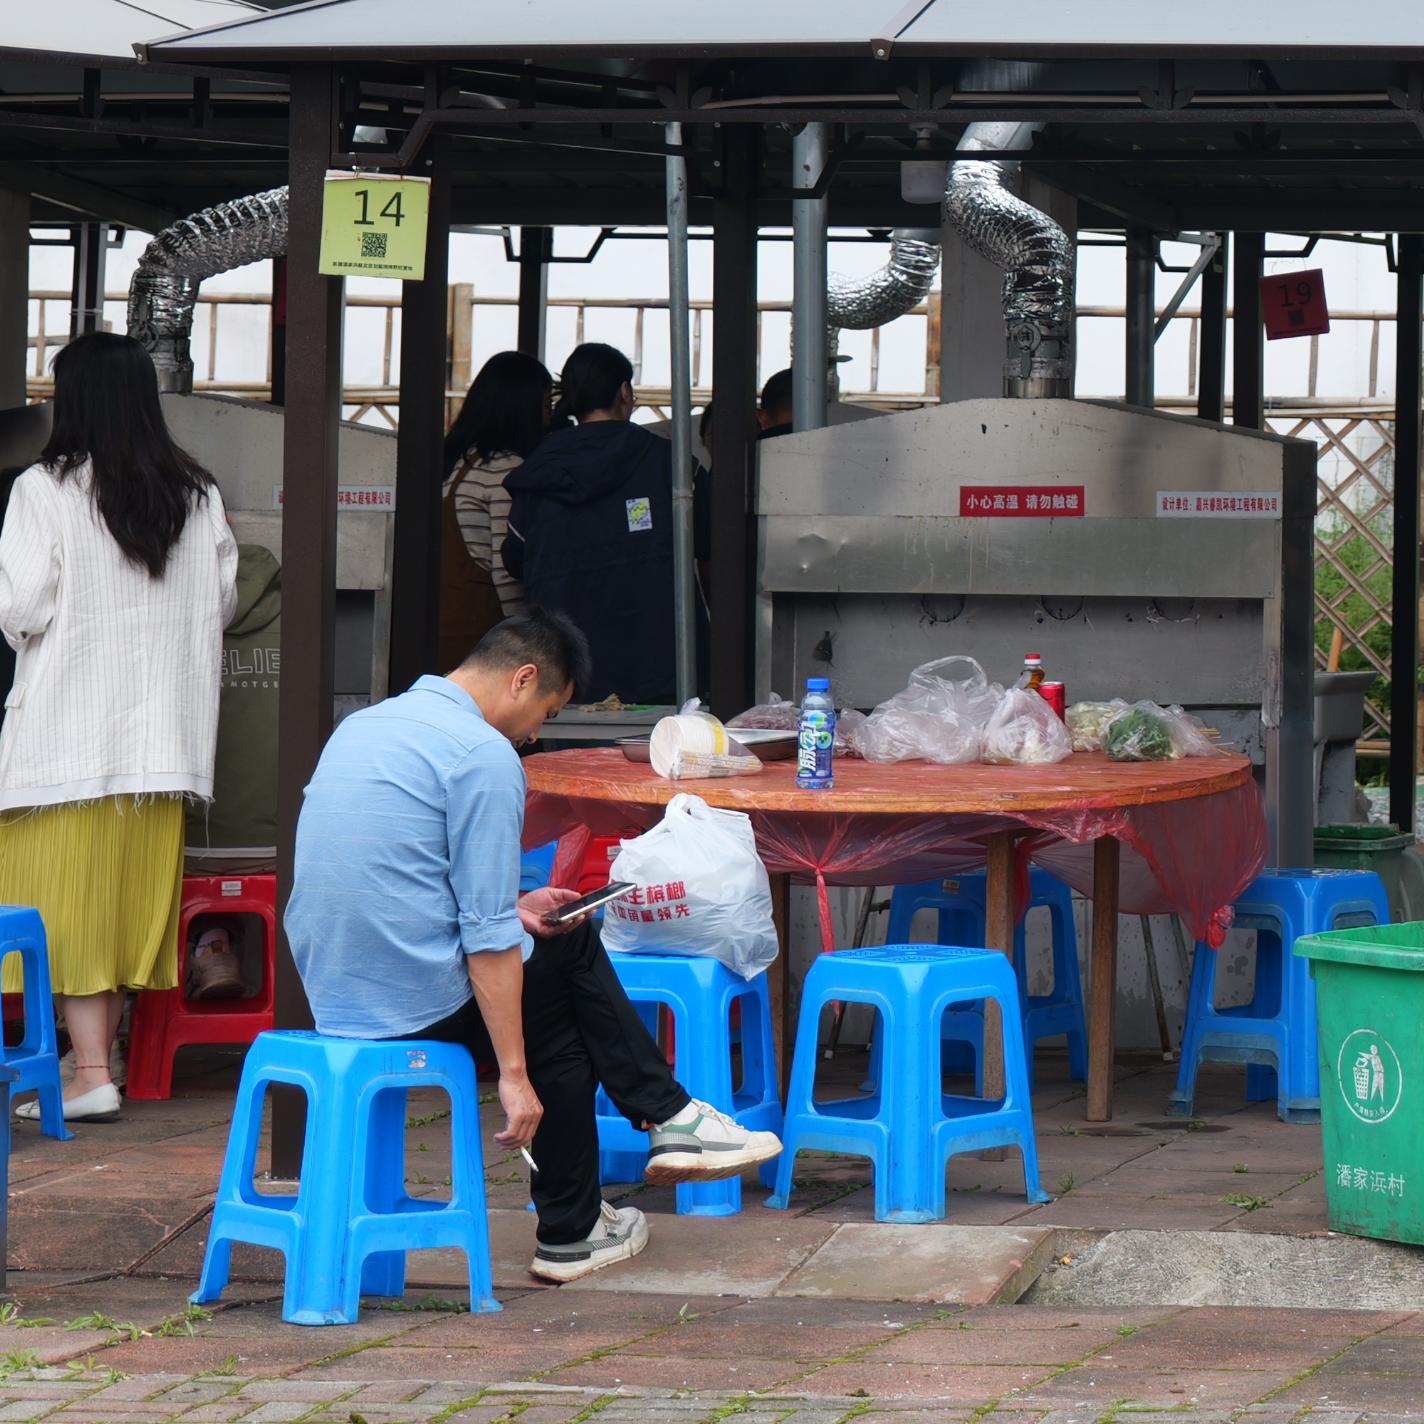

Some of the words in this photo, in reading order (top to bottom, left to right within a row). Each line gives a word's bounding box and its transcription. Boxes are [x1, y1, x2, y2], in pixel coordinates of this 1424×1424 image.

[353, 189, 406, 227] 14
[1279, 281, 1312, 307] 19
[966, 493, 1019, 511] 小心高温
[1025, 493, 1080, 511] 请勿触碰
[1336, 1162, 1406, 1198] 潘家浜村
